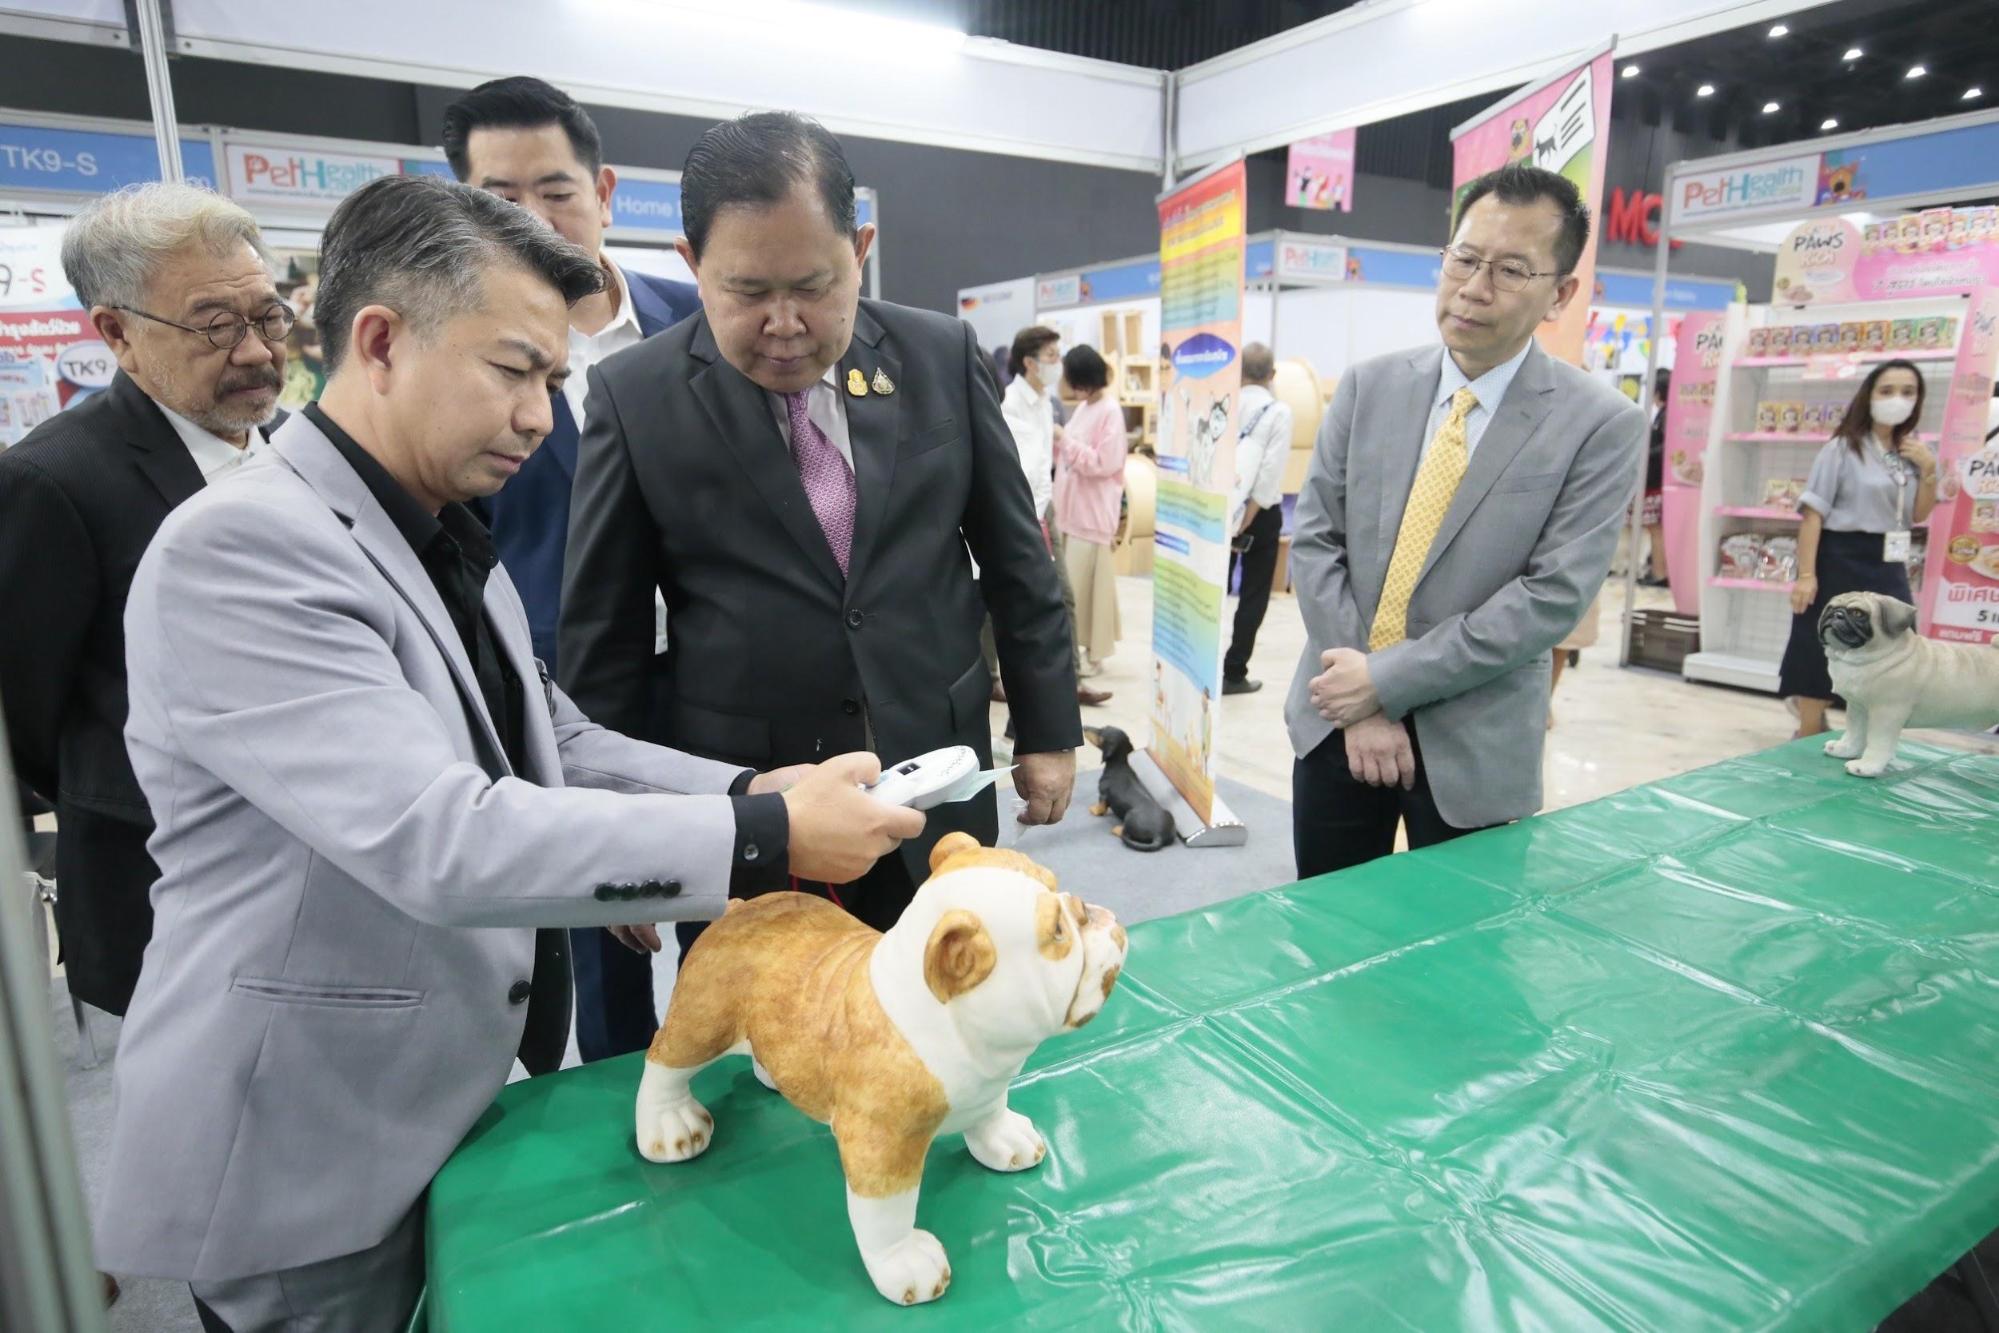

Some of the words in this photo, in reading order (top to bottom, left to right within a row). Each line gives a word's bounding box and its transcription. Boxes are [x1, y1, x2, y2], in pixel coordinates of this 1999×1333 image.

[0, 144, 99, 176] TK9-S
[616, 195, 673, 217] Home
[1607, 186, 1686, 248] MC
[1794, 231, 1844, 251] PAWS
[1695, 333, 1723, 350] PA
[1969, 460, 1999, 477] PA
